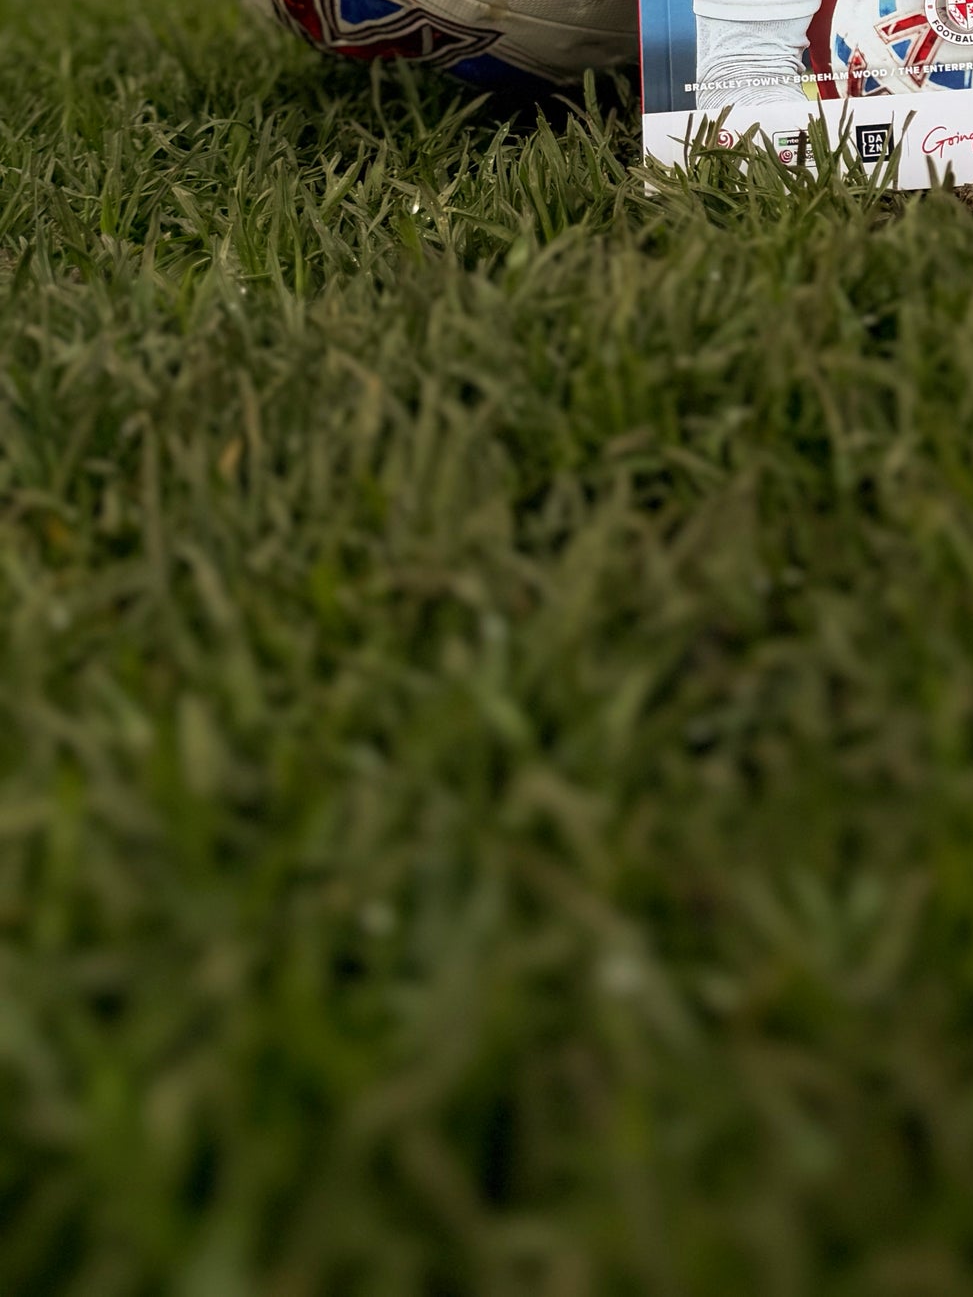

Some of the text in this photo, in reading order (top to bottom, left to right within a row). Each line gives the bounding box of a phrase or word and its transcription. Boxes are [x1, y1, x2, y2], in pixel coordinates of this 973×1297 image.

[684, 78, 742, 93] BRACKLEY
[746, 76, 780, 88] TOWN
[782, 75, 791, 86] V
[793, 71, 849, 84] BOREHAM
[852, 68, 888, 80] WOOD
[898, 65, 920, 77] THE
